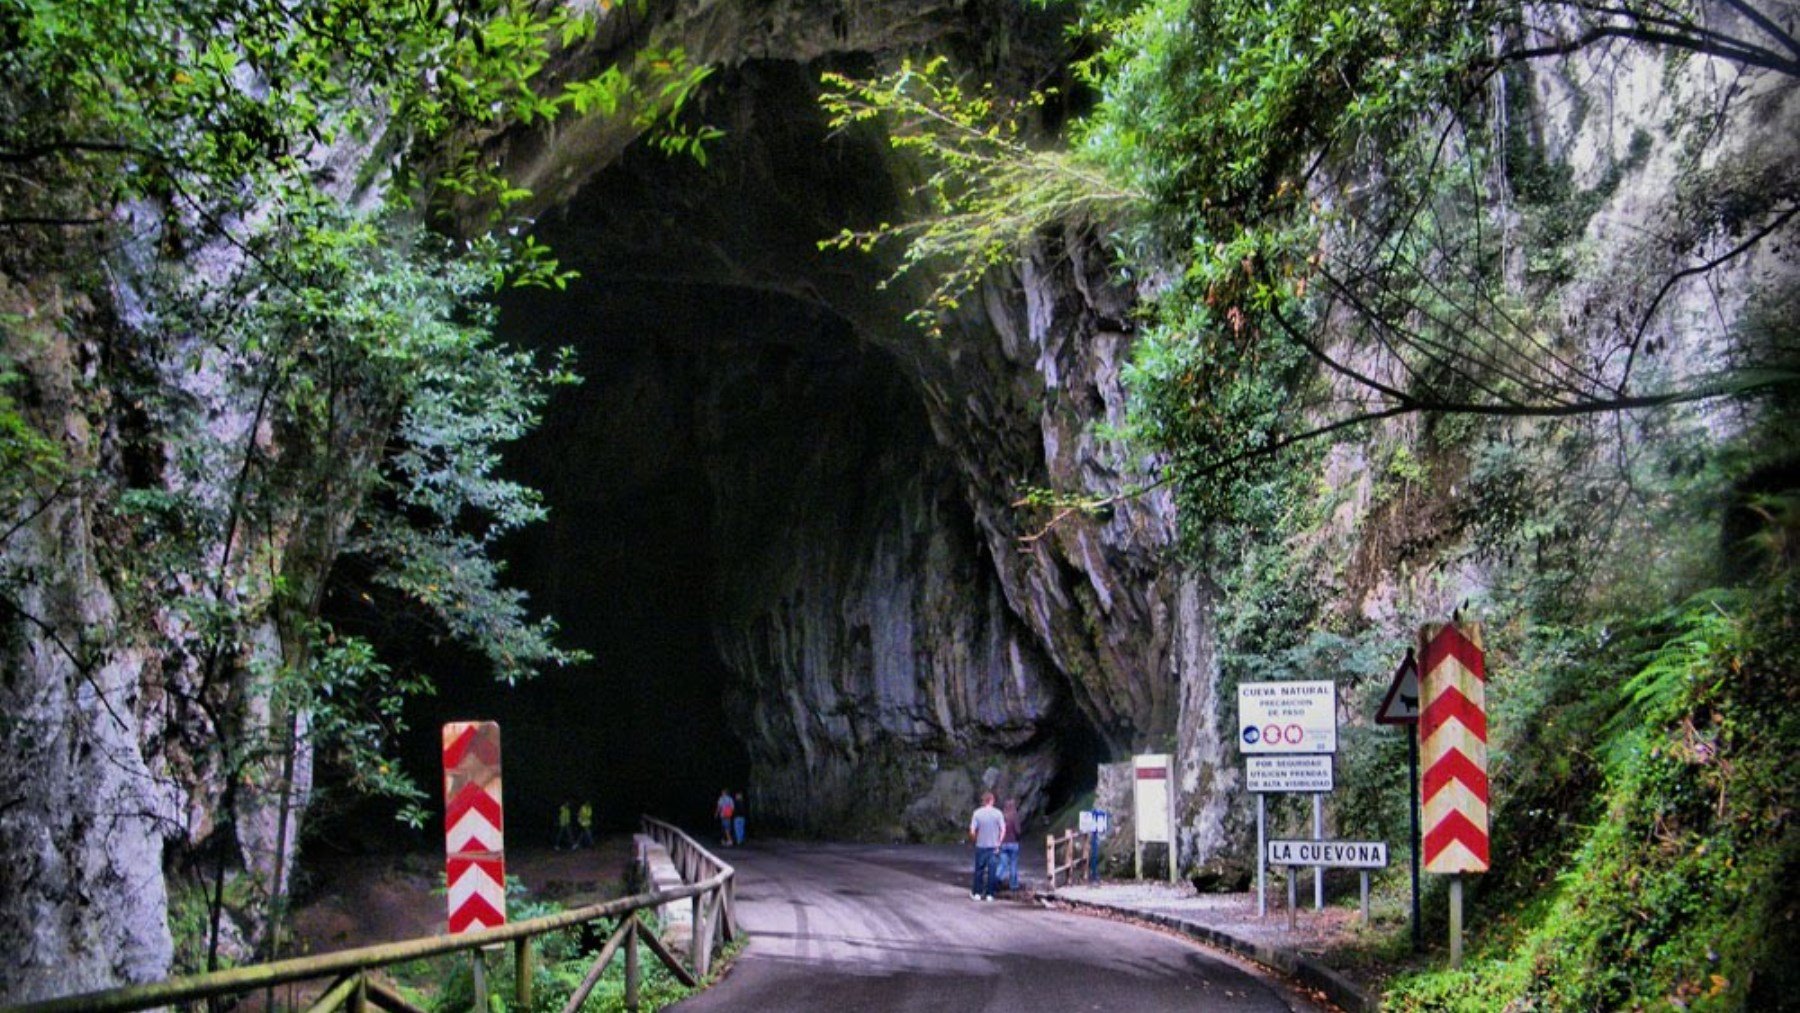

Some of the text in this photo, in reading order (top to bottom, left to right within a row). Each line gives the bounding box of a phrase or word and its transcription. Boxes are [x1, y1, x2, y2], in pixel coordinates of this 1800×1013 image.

[1243, 686, 1329, 697] CUEVA NATURAL
[1285, 780, 1330, 788] VISIBILIDAD
[1273, 844, 1380, 861] LA CUEVONA
